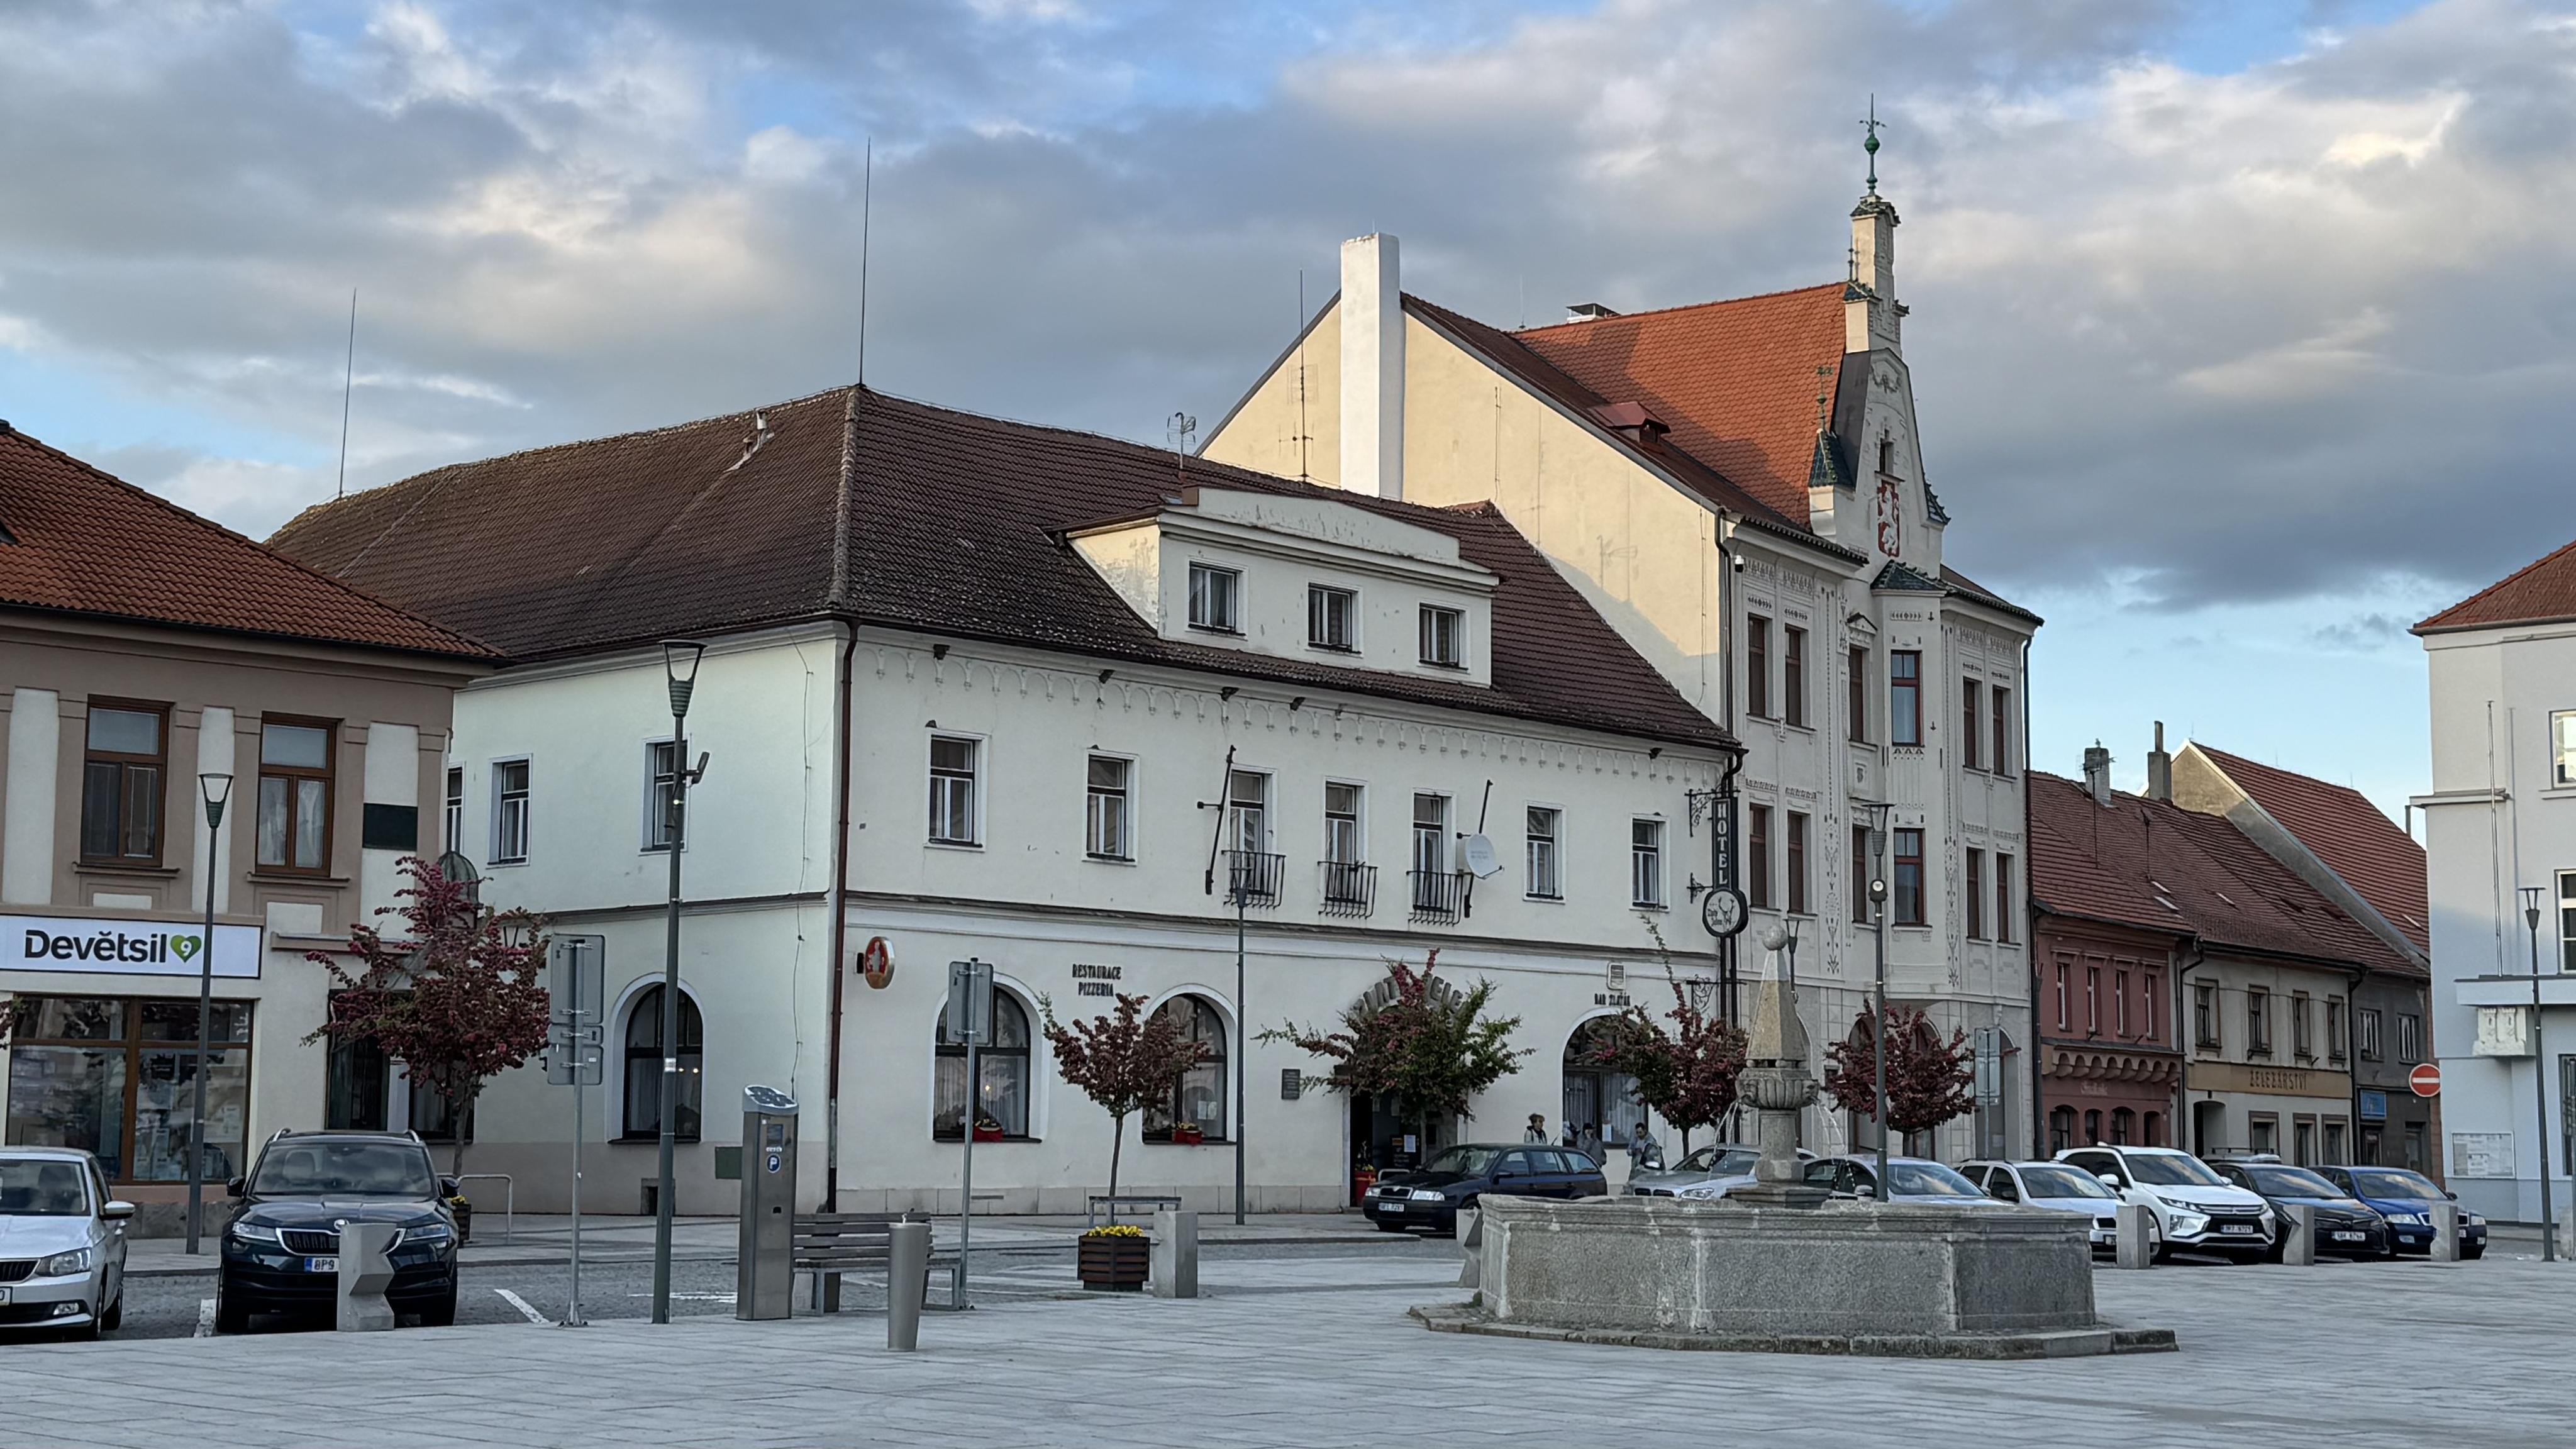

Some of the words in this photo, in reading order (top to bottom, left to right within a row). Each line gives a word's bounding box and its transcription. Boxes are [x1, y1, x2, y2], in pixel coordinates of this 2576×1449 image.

[1717, 804, 1728, 885] HOTEL
[25, 929, 167, 963] Devětsil
[1072, 963, 1121, 980] RESTAURACE
[1078, 982, 1114, 997] PIZZERIA
